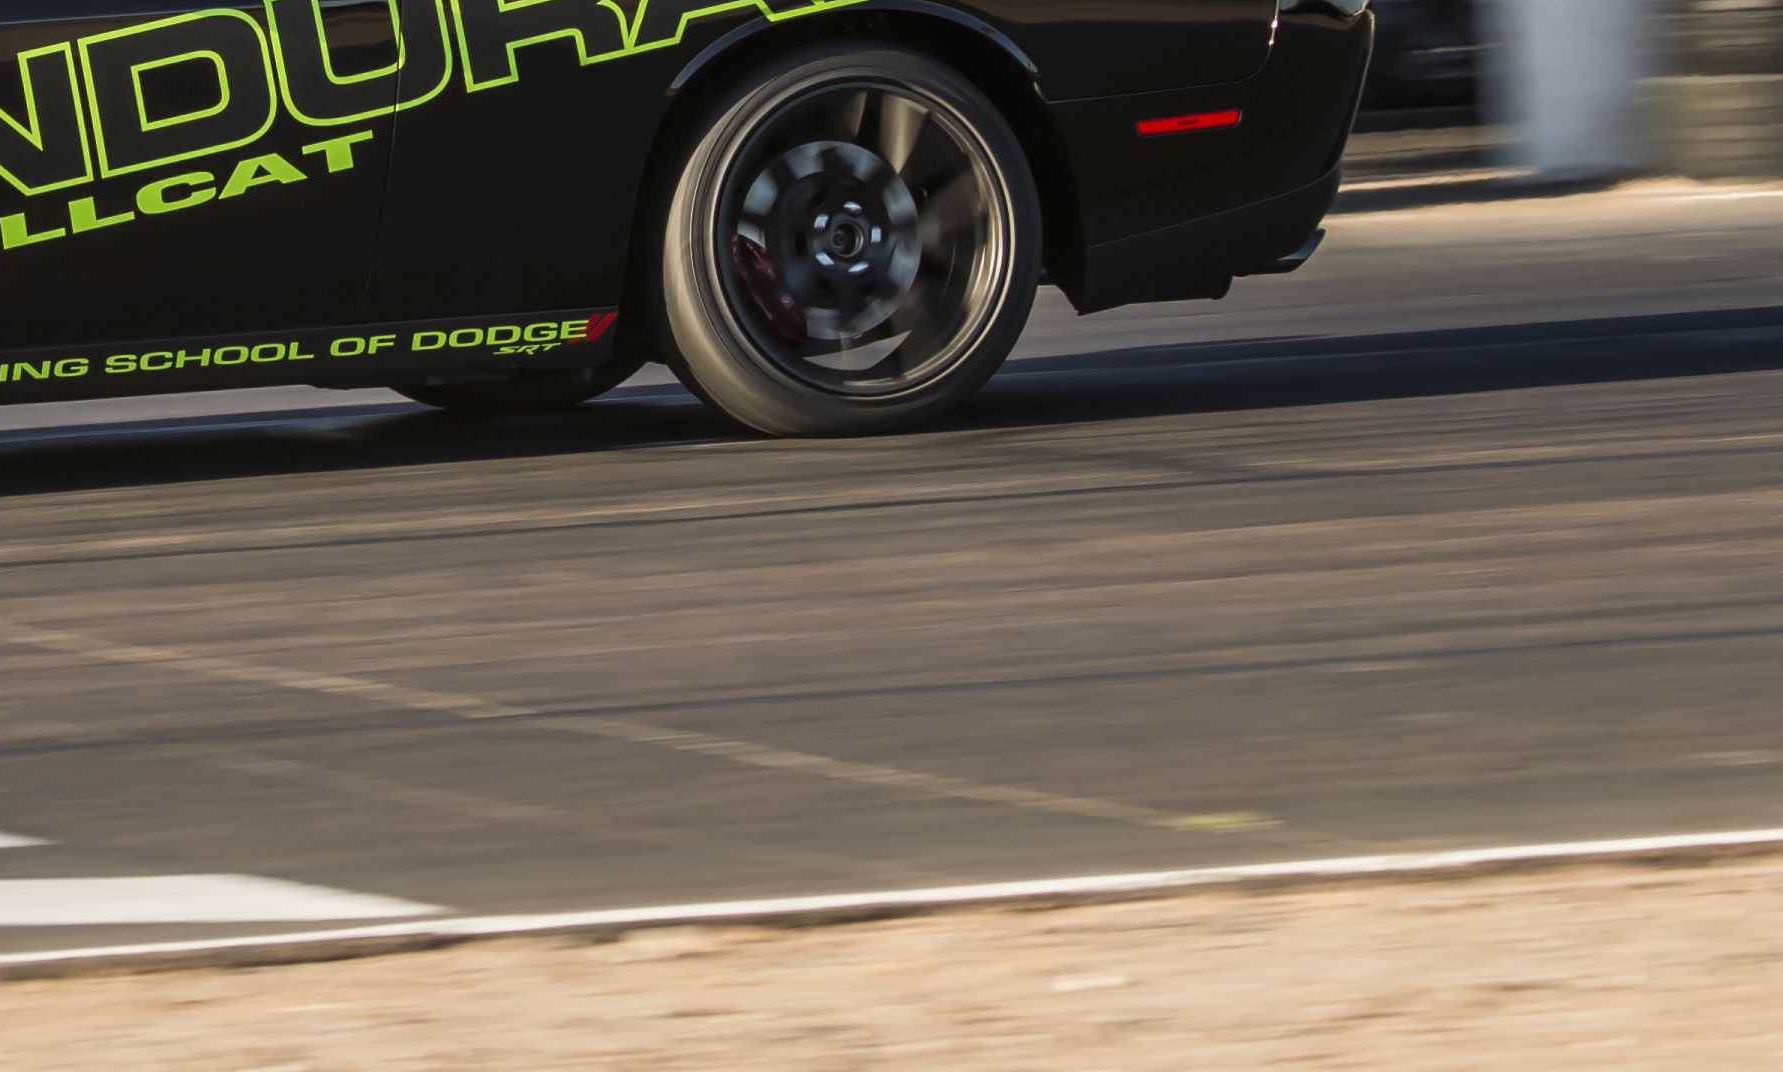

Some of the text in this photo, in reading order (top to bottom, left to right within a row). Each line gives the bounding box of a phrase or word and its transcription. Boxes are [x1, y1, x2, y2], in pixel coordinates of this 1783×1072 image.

[105, 342, 315, 374] SCHOOL
[329, 334, 396, 357] OF
[412, 320, 589, 352] DODGE
[493, 342, 562, 355] SRT
